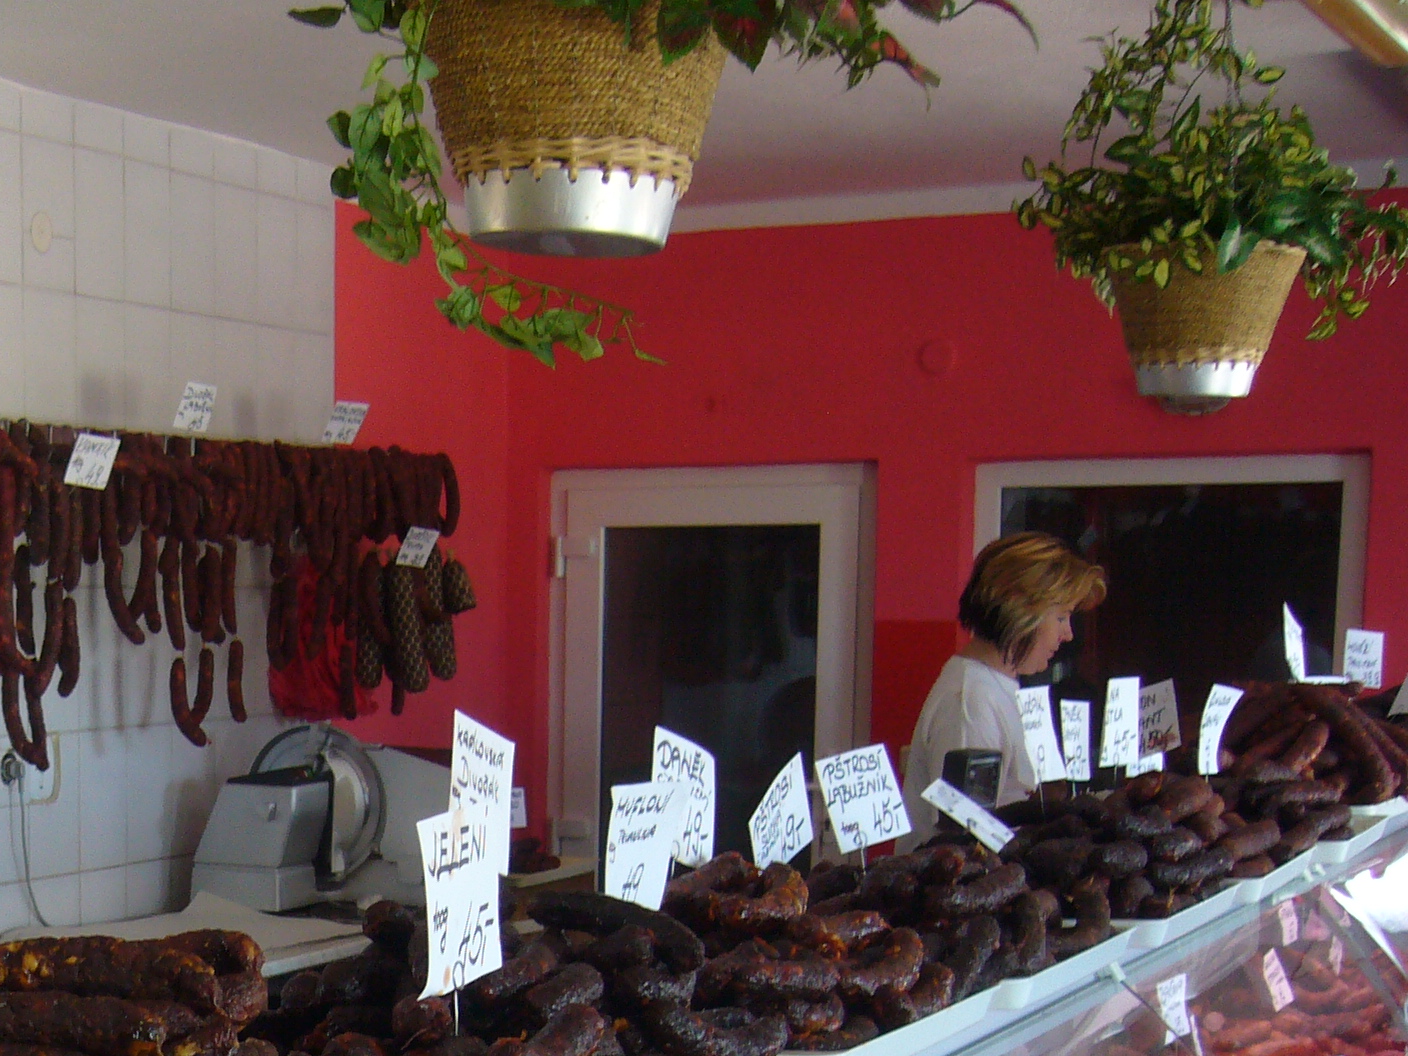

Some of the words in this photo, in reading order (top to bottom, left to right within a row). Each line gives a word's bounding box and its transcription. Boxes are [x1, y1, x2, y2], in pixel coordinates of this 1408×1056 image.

[656, 739, 706, 788] DANĚK
[822, 748, 884, 783] PŠTROSÍ
[827, 773, 892, 814] LABUŽNÍK
[873, 796, 903, 836] 45,-
[427, 806, 487, 881] JELENÍ
